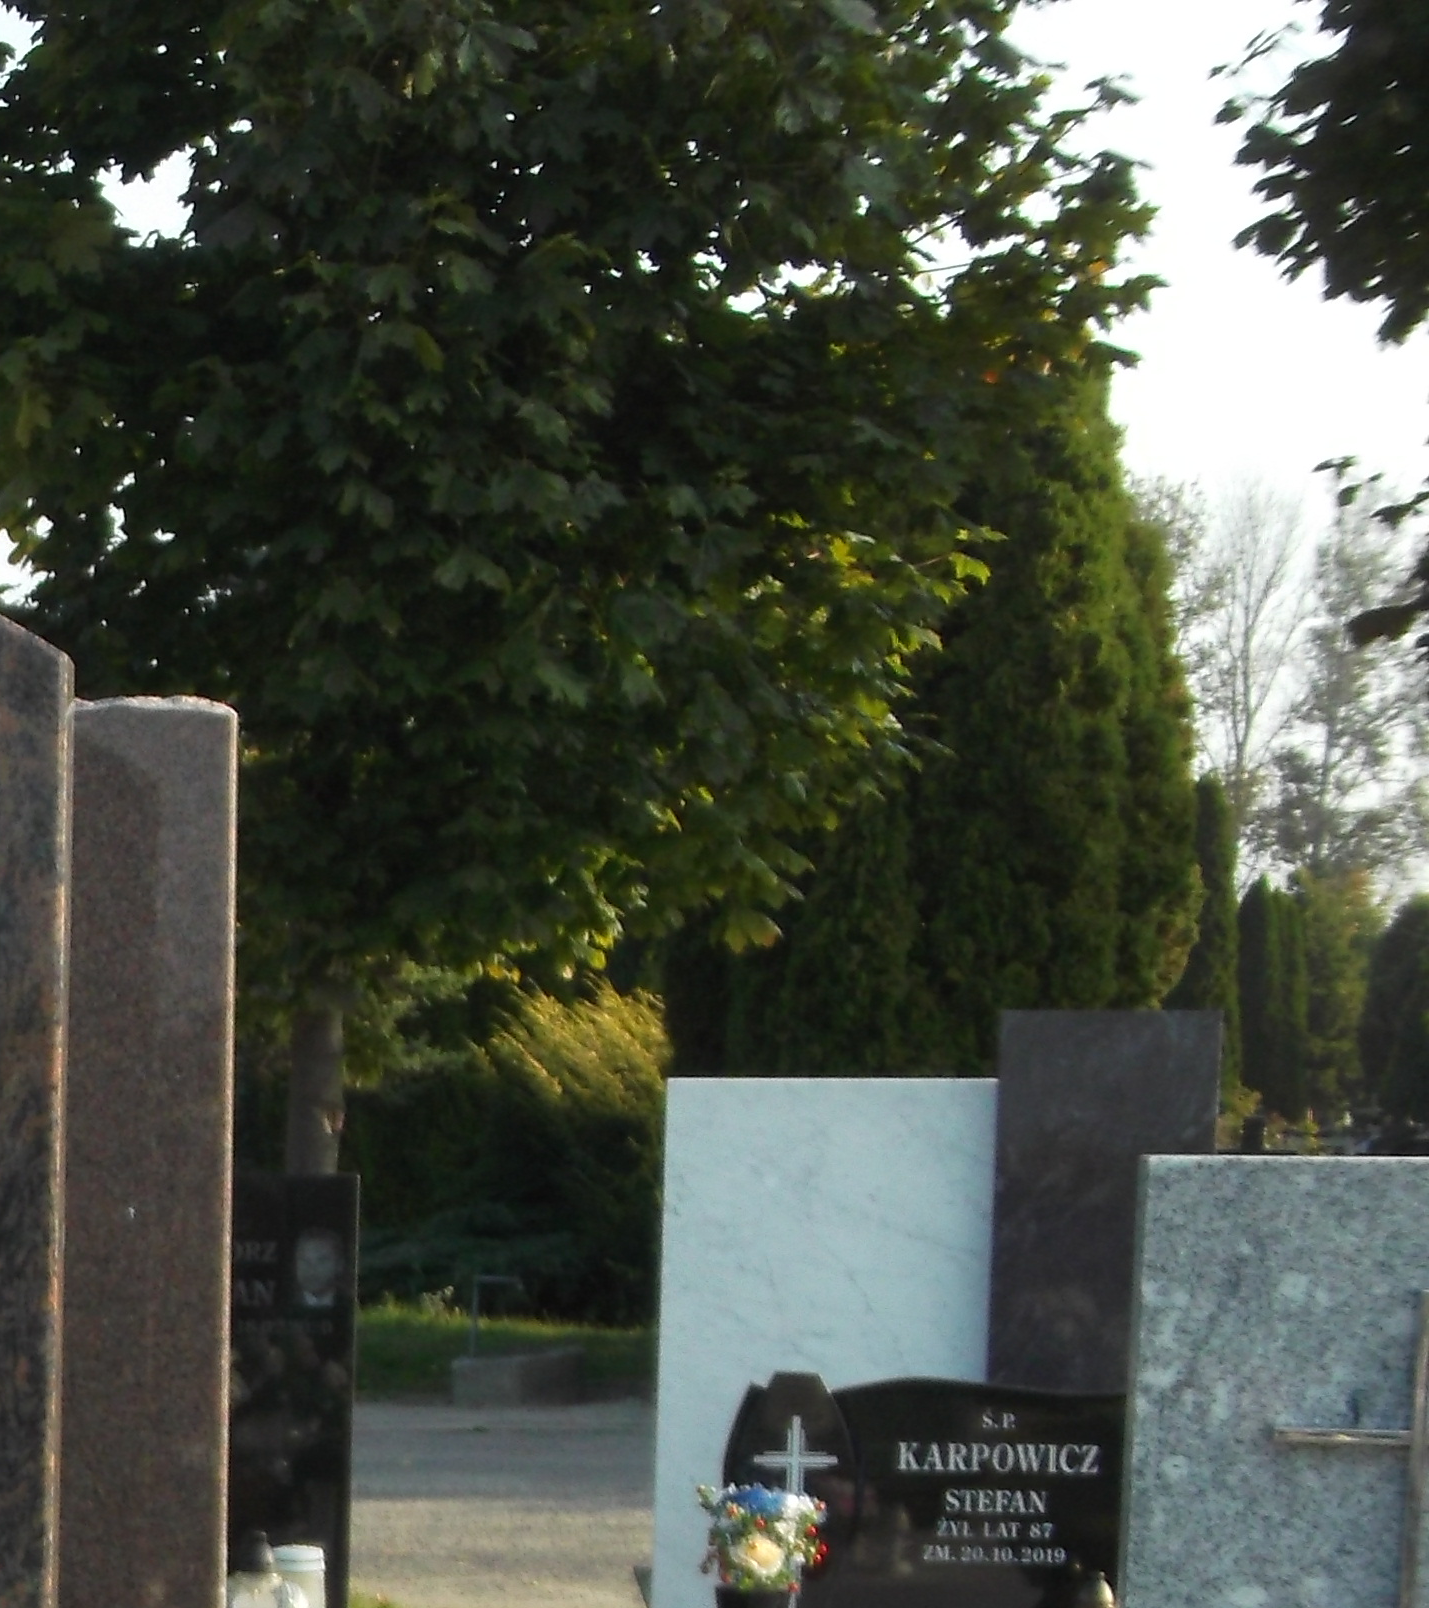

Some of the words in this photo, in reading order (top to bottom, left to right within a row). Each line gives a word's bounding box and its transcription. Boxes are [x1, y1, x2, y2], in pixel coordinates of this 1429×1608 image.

[896, 1441, 1102, 1474] KARPOWICZ
[944, 1488, 1048, 1514] STEFAN
[983, 1521, 1021, 1538] LAT
[1029, 1523, 1055, 1540] 87
